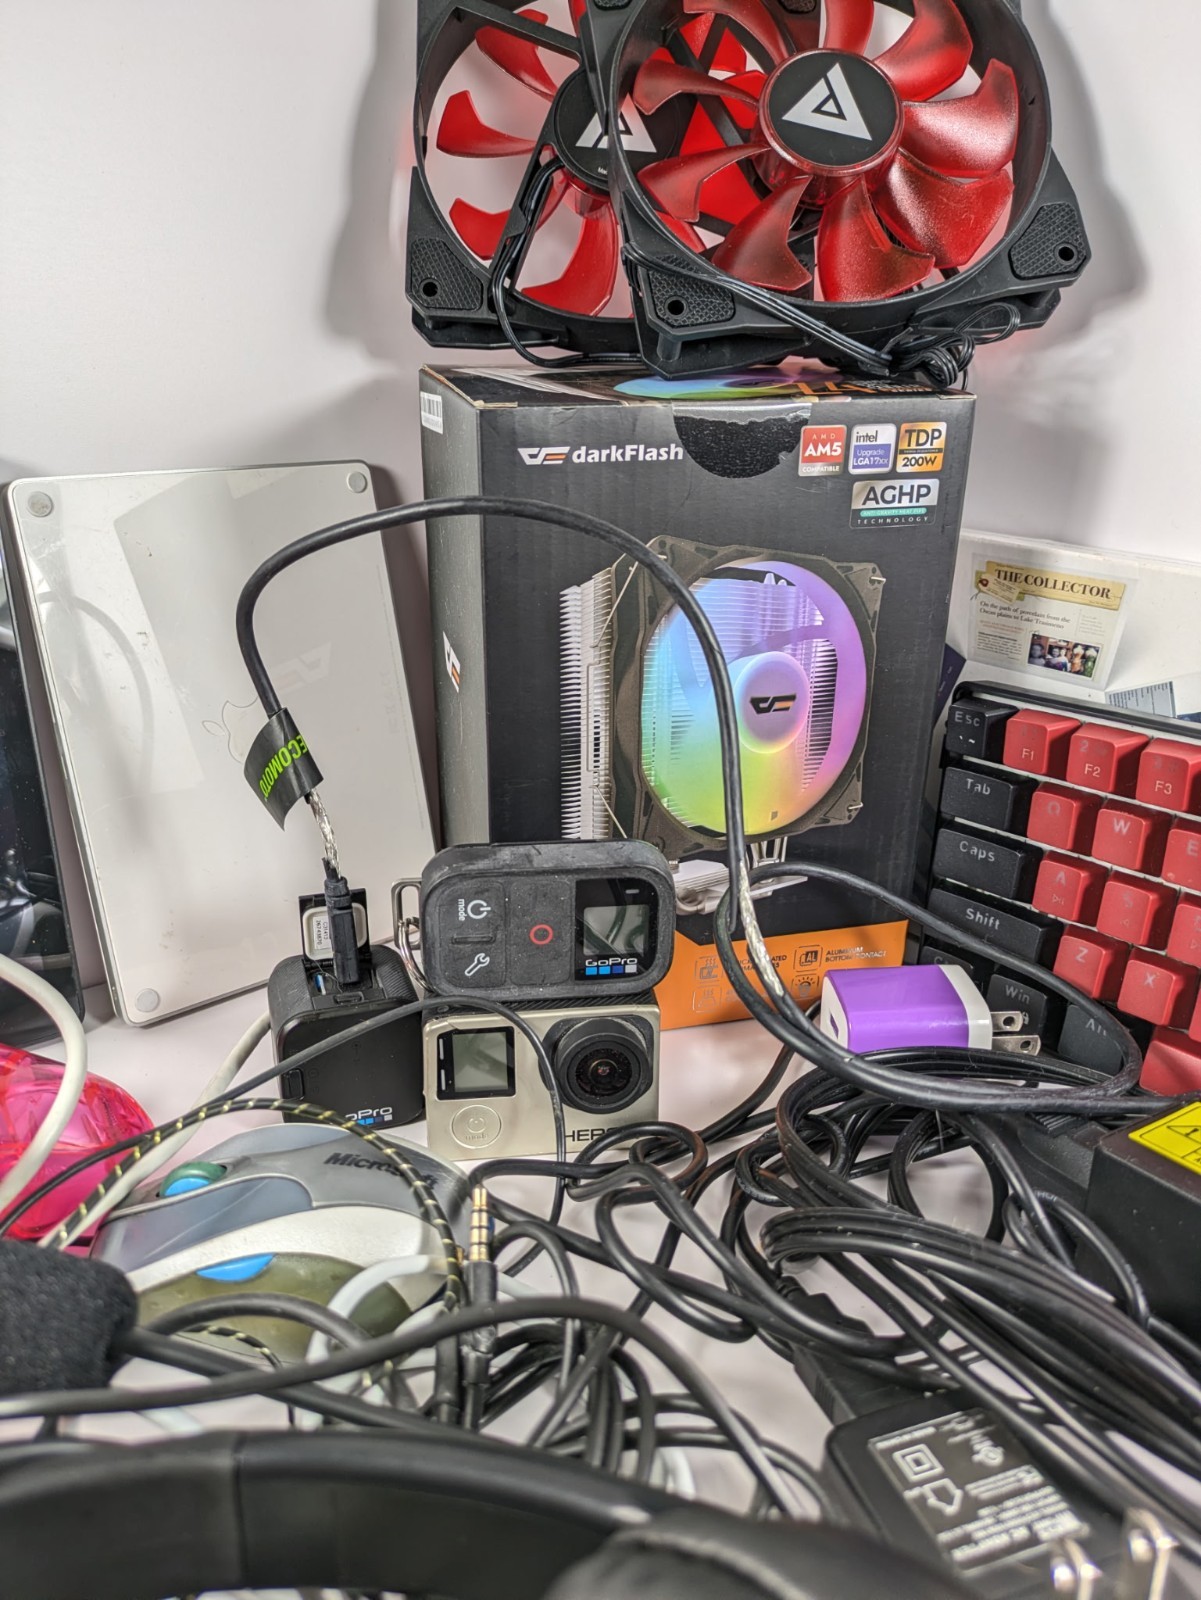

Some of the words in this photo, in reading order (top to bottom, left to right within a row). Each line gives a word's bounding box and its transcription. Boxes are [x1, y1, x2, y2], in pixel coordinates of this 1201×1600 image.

[856, 430, 878, 443] intel
[905, 428, 942, 448] TDP
[572, 444, 684, 463] darkFlash
[804, 442, 842, 457] AM5
[857, 449, 885, 458] Upgrade
[802, 465, 840, 473] COMPATIBLE
[902, 456, 938, 468] 200W
[862, 484, 931, 506] AGHP
[857, 516, 929, 525] TECHNOLOGY
[995, 568, 1023, 584] THE
[1024, 574, 1111, 600] COLLECTOR
[999, 604, 1011, 612] path
[954, 711, 980, 726] Esc
[1022, 748, 1034, 760] F1
[1084, 764, 1100, 778] F2
[966, 778, 991, 795] Tab
[1154, 780, 1172, 795] F3
[1112, 818, 1130, 835] W
[959, 840, 996, 862] Caps
[1186, 840, 1198, 856] E
[1055, 870, 1066, 886] A
[458, 898, 467, 921] mode
[966, 908, 1001, 930] Shift
[585, 957, 638, 967] GoPro
[1075, 946, 1089, 963] Z
[1144, 972, 1156, 989] X
[1005, 984, 1030, 1004] Win
[344, 1106, 393, 1121] oPro
[564, 1127, 618, 1142] HER
